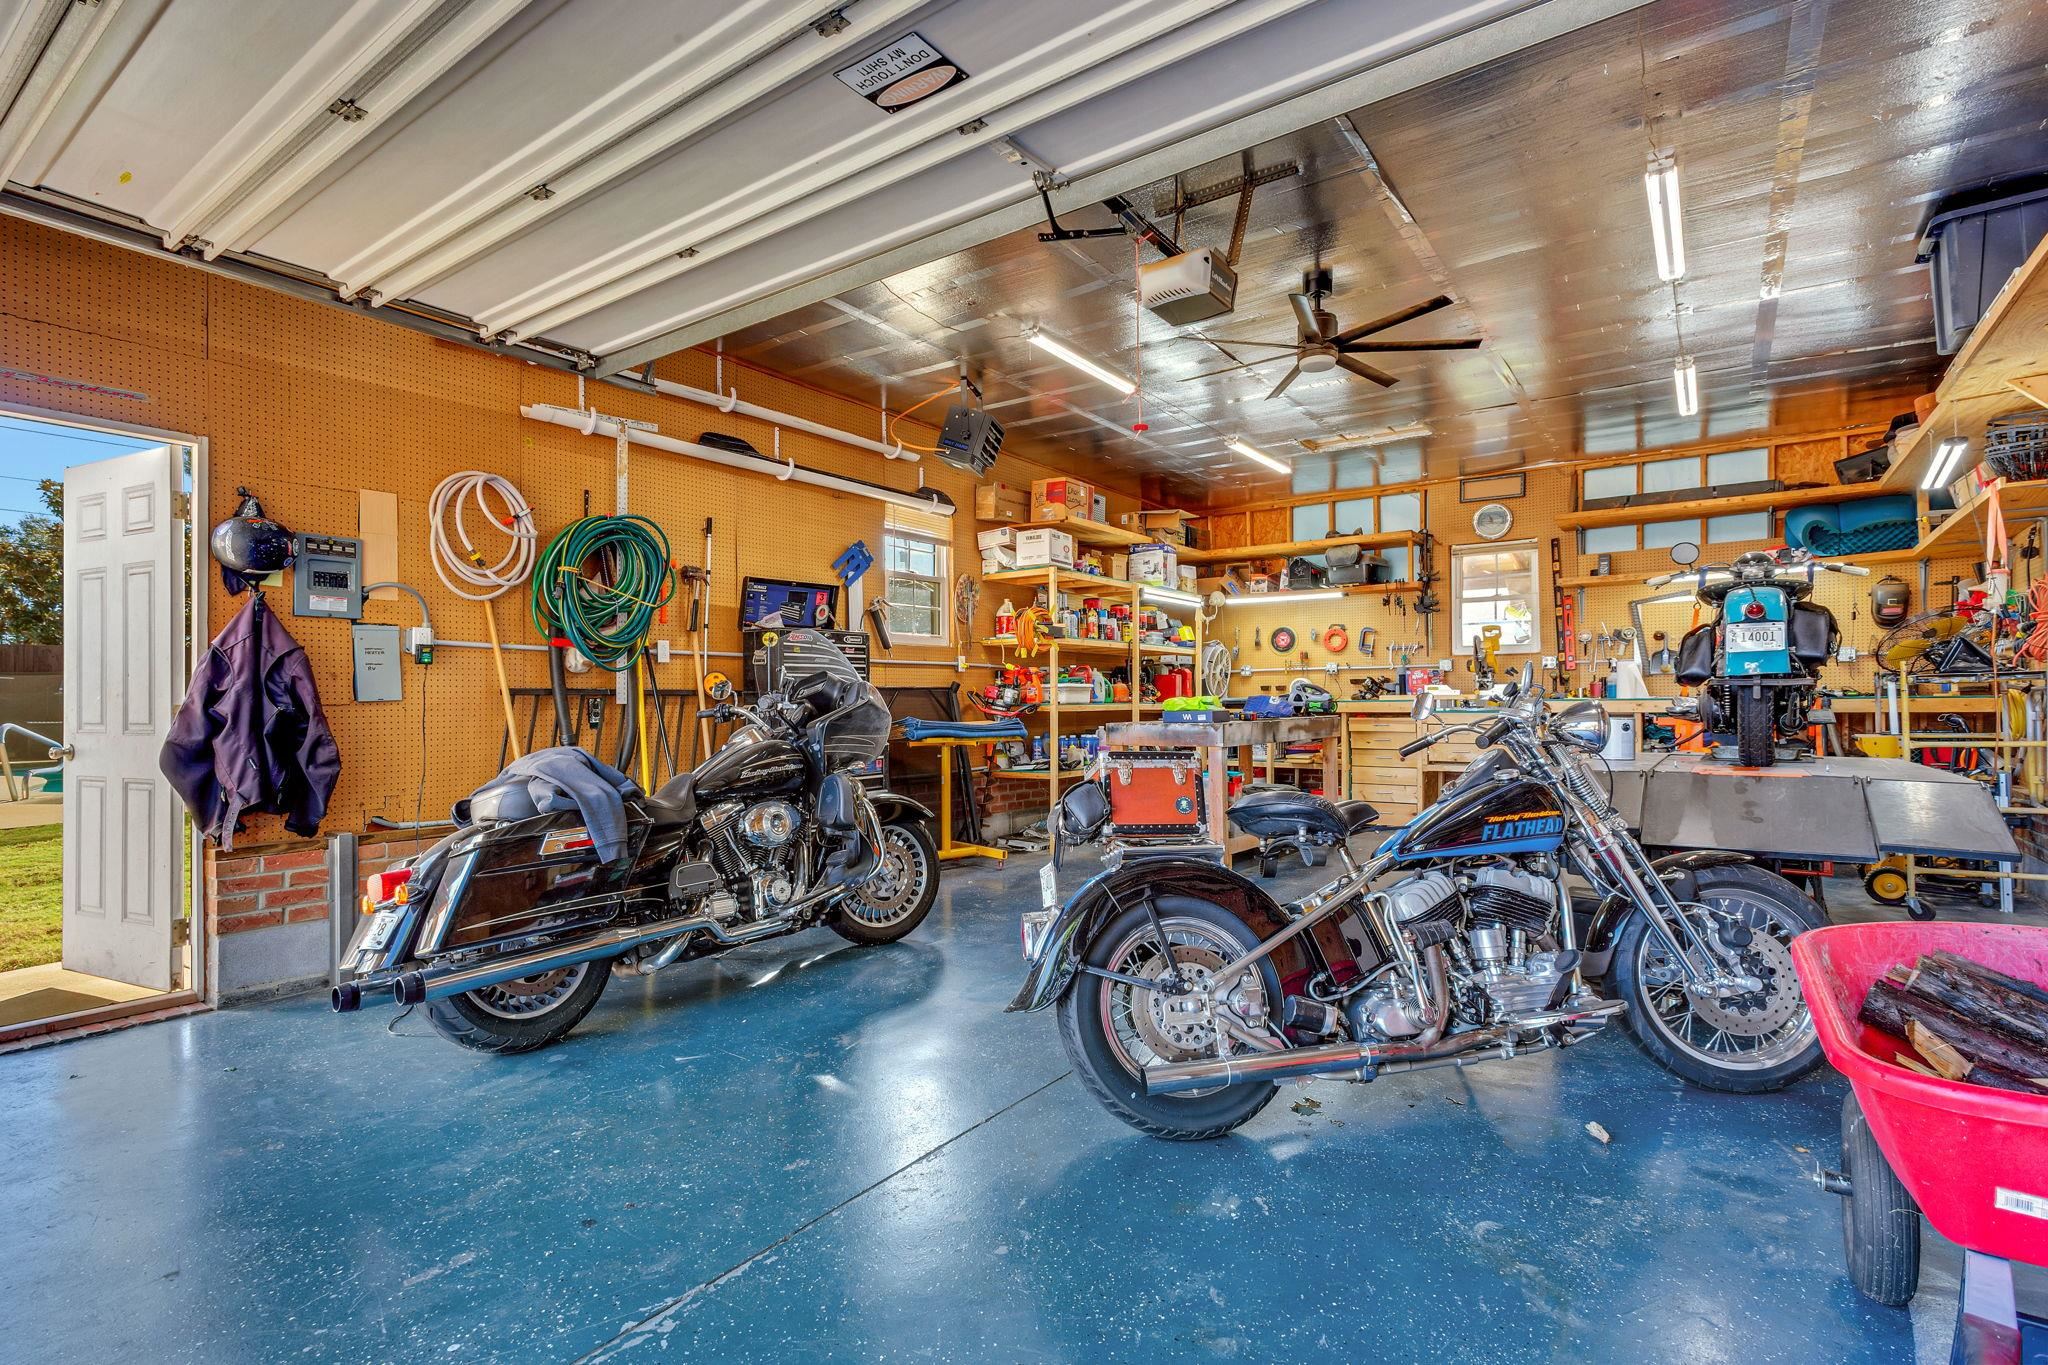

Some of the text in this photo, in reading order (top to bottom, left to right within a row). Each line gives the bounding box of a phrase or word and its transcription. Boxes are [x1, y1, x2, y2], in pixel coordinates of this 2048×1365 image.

[856, 49, 930, 90] DON'T TOUCH
[857, 48, 906, 76] MY SHIT!
[1481, 816, 1563, 841] FLATHEAD
